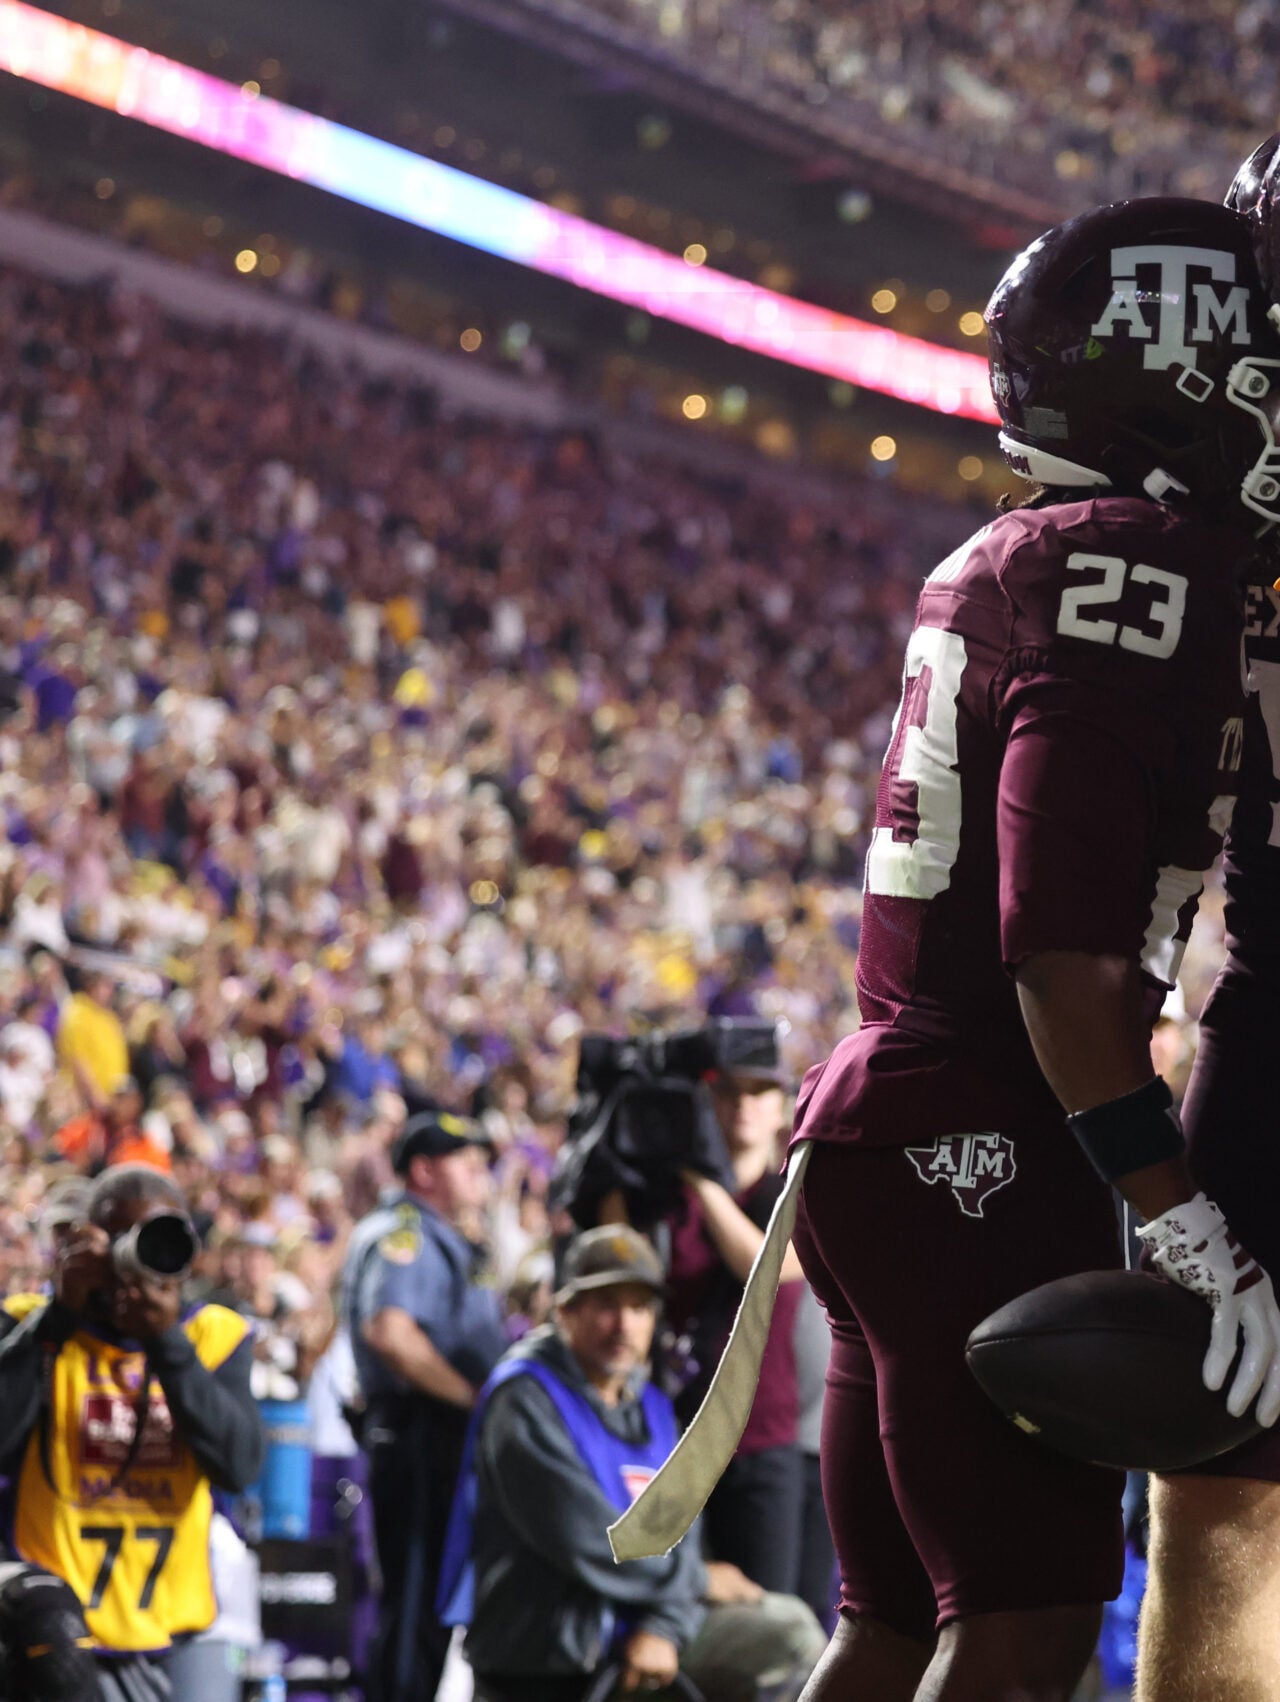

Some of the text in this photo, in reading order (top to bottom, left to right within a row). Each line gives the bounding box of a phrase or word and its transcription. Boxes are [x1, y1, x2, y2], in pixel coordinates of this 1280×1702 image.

[1091, 245, 1251, 371] ATM
[1057, 552, 1189, 659] 23
[863, 625, 968, 900] 3
[80, 1527, 175, 1610] 77
